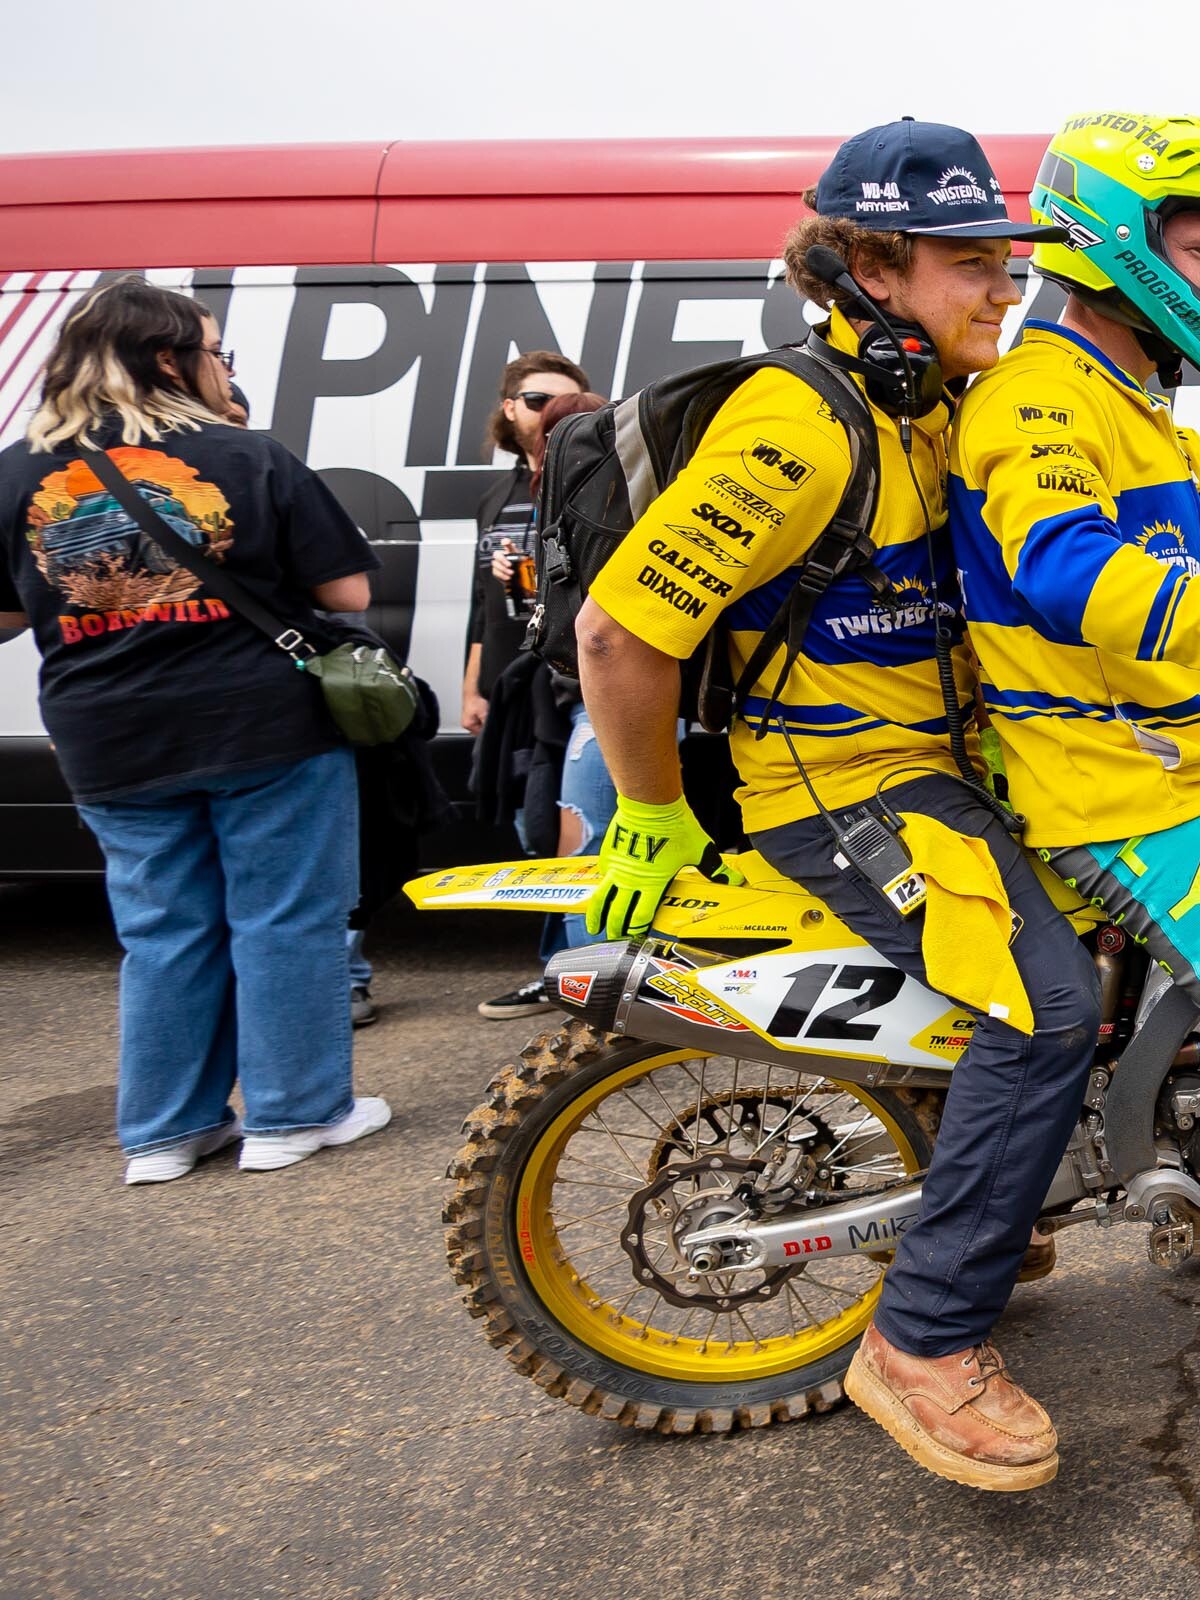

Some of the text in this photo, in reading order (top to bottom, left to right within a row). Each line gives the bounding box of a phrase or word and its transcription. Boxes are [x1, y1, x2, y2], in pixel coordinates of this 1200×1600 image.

[1135, 125, 1170, 157] TEA
[856, 201, 910, 212] MAYHEM
[861, 182, 900, 199] WD-40
[926, 185, 973, 205] TWISTED
[751, 443, 807, 484] WD-40
[710, 473, 785, 526] ECSTAR
[648, 539, 733, 598] GALFER
[636, 565, 708, 620] DIXXON
[825, 607, 928, 640] TWISTED
[611, 823, 670, 864] FLY
[491, 889, 587, 900] PROGRESSIVE
[894, 878, 920, 904] 12
[744, 924, 788, 932] MCELRATH
[726, 969, 757, 979] AMA
[649, 975, 740, 1027] CIRCUIT
[766, 963, 906, 1041] 12
